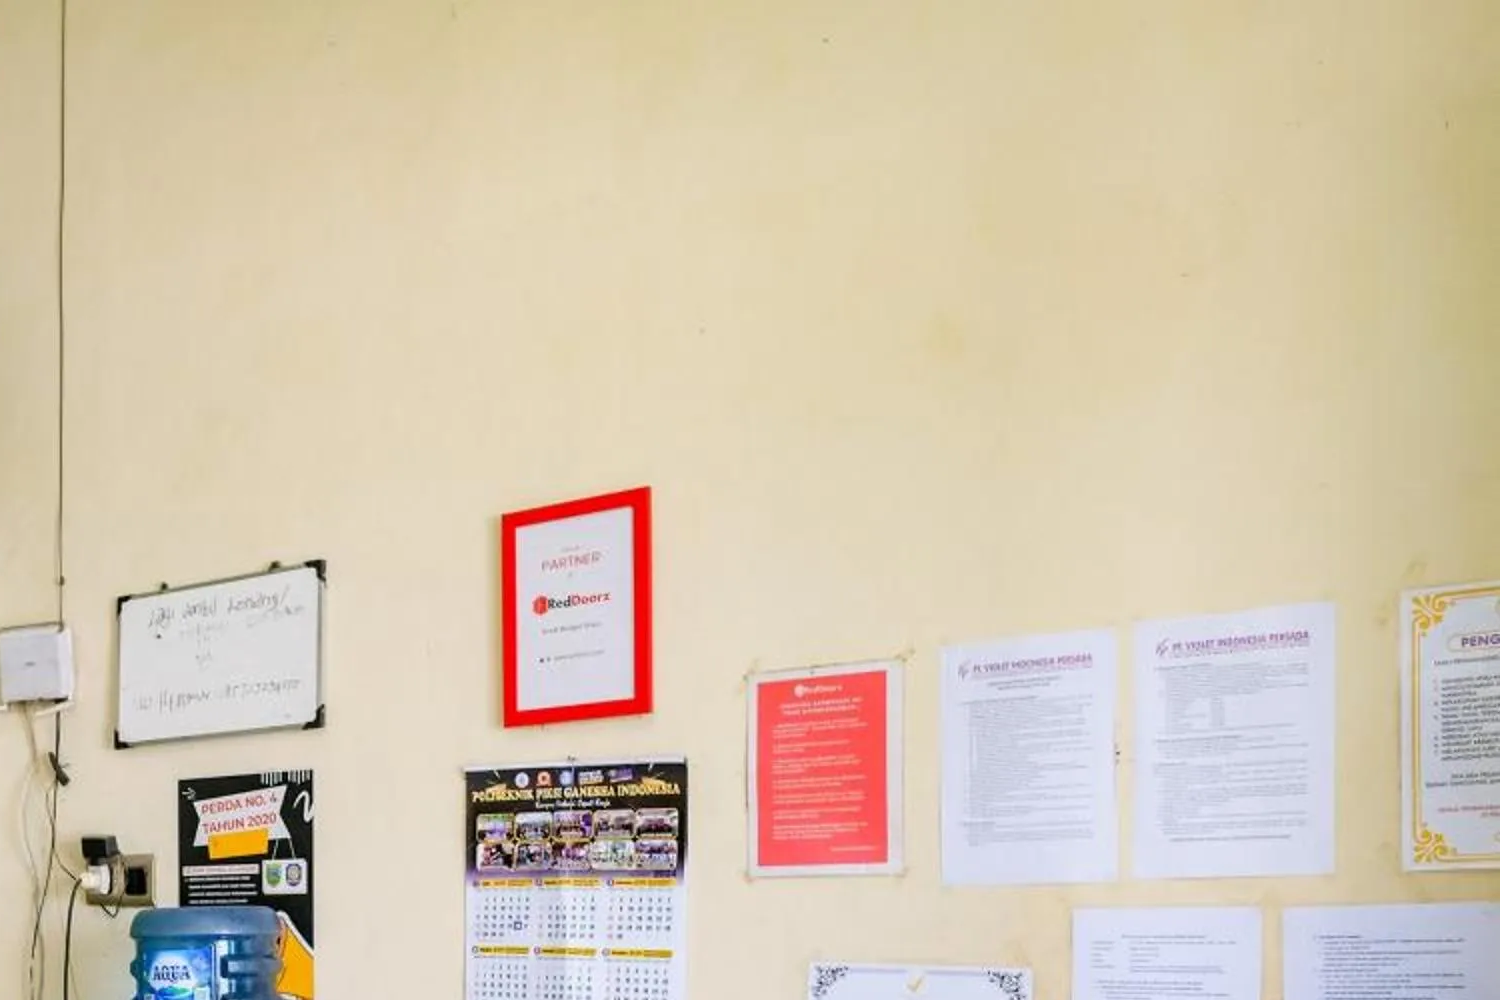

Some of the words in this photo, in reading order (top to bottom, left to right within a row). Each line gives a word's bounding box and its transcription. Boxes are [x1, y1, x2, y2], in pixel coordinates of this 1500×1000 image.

[548, 592, 610, 609] RedDoorz
[1217, 635, 1267, 648] INDONESIA
[617, 782, 680, 797] INDONESIA
[201, 799, 242, 814] PERDA
[201, 818, 245, 834] TAHUN
[247, 813, 277, 827] 2020
[153, 965, 191, 982] AQUA
